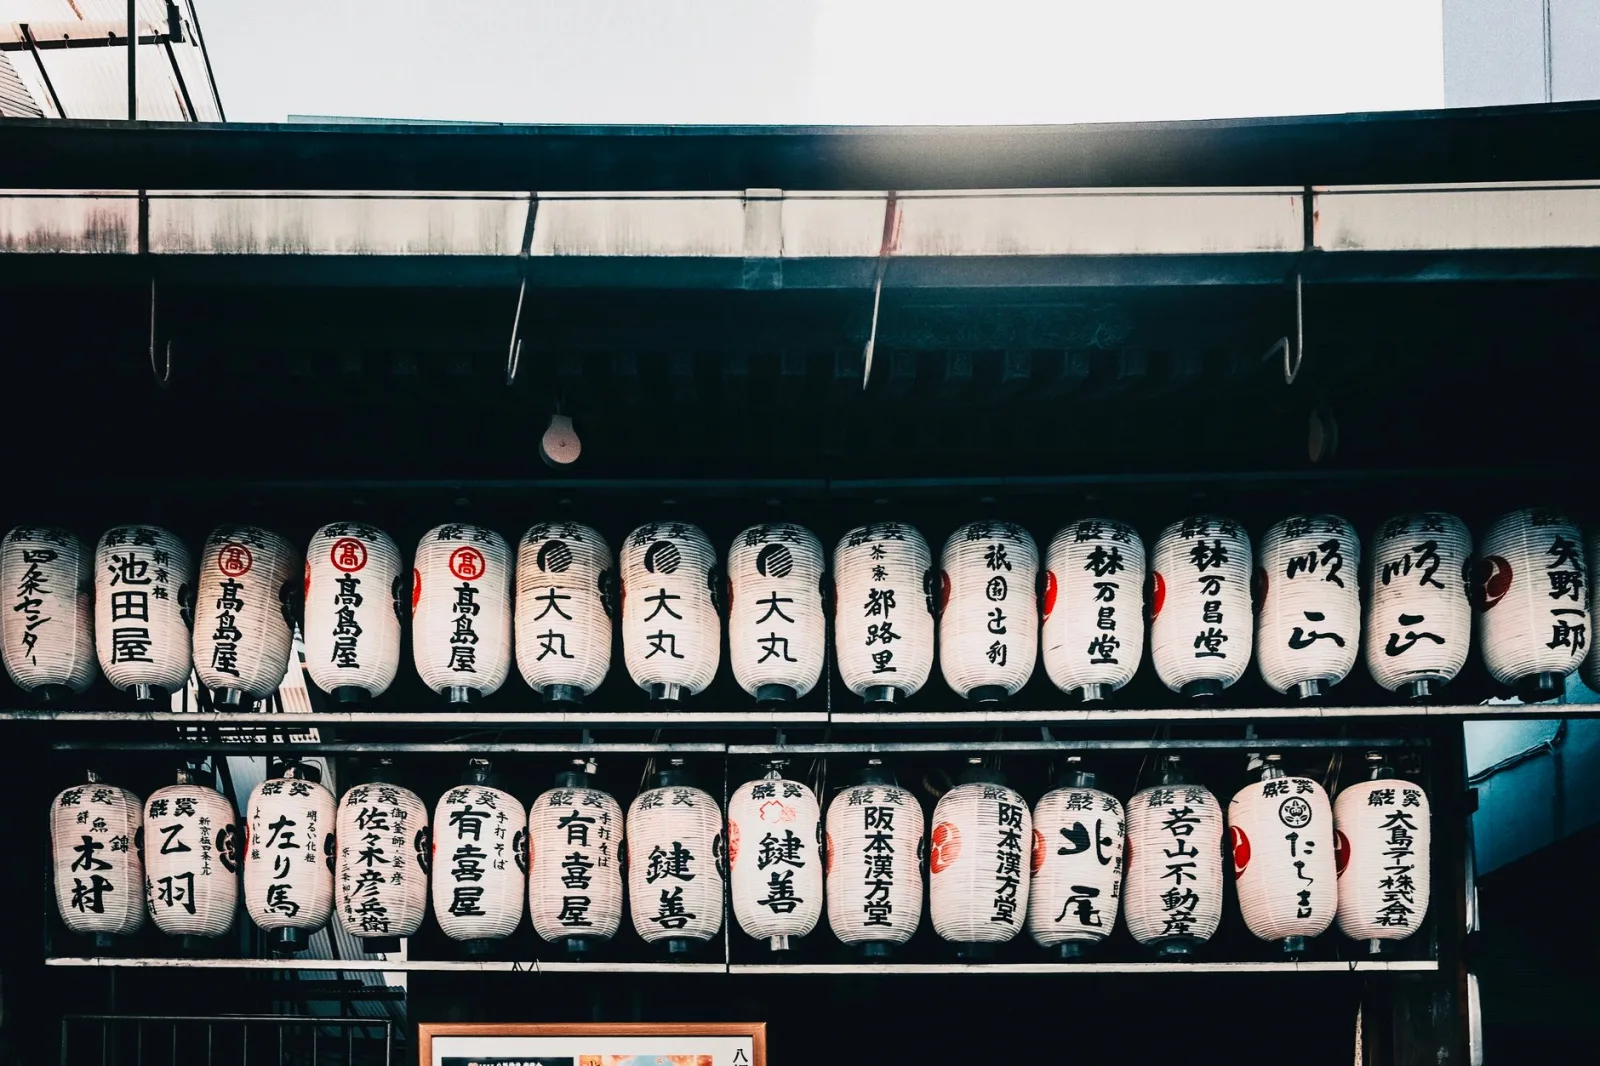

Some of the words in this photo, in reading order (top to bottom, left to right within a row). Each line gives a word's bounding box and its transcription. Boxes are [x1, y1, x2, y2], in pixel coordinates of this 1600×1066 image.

[14, 550, 58, 666] 四条センター
[108, 552, 154, 665] 池田屋
[152, 550, 169, 600] 新京極
[534, 587, 575, 661] 大丸
[644, 587, 685, 660] 大丸
[756, 591, 798, 664] 大丸
[1083, 545, 1125, 665] 林万昌堂
[1188, 539, 1230, 659] 林万昌堂
[1286, 538, 1345, 650] 順正
[1382, 539, 1446, 657] 順正
[1546, 534, 1587, 657] 矢野一郎
[71, 835, 114, 914] 木村
[109, 834, 129, 854] 錦
[157, 823, 196, 915] 乙羽
[264, 814, 301, 918] 左り馬
[304, 810, 317, 863] 明るい化粧
[351, 806, 391, 932] 佐々木彦兵衛
[448, 804, 491, 917] 有喜屋
[493, 811, 508, 871] 手打そば
[557, 809, 596, 927] 有喜屋
[598, 811, 612, 868] 手打そば
[646, 841, 696, 929] 鍵善
[757, 829, 805, 914] 鍵善
[863, 806, 895, 927] 阪本漢方堂
[990, 802, 1022, 925] 阪本漢方堂
[1055, 818, 1111, 927] 北尾
[1159, 806, 1201, 937] 若山不動産
[1373, 809, 1418, 928] 大島テープ株式会社
[732, 1048, 748, 1066] 八
